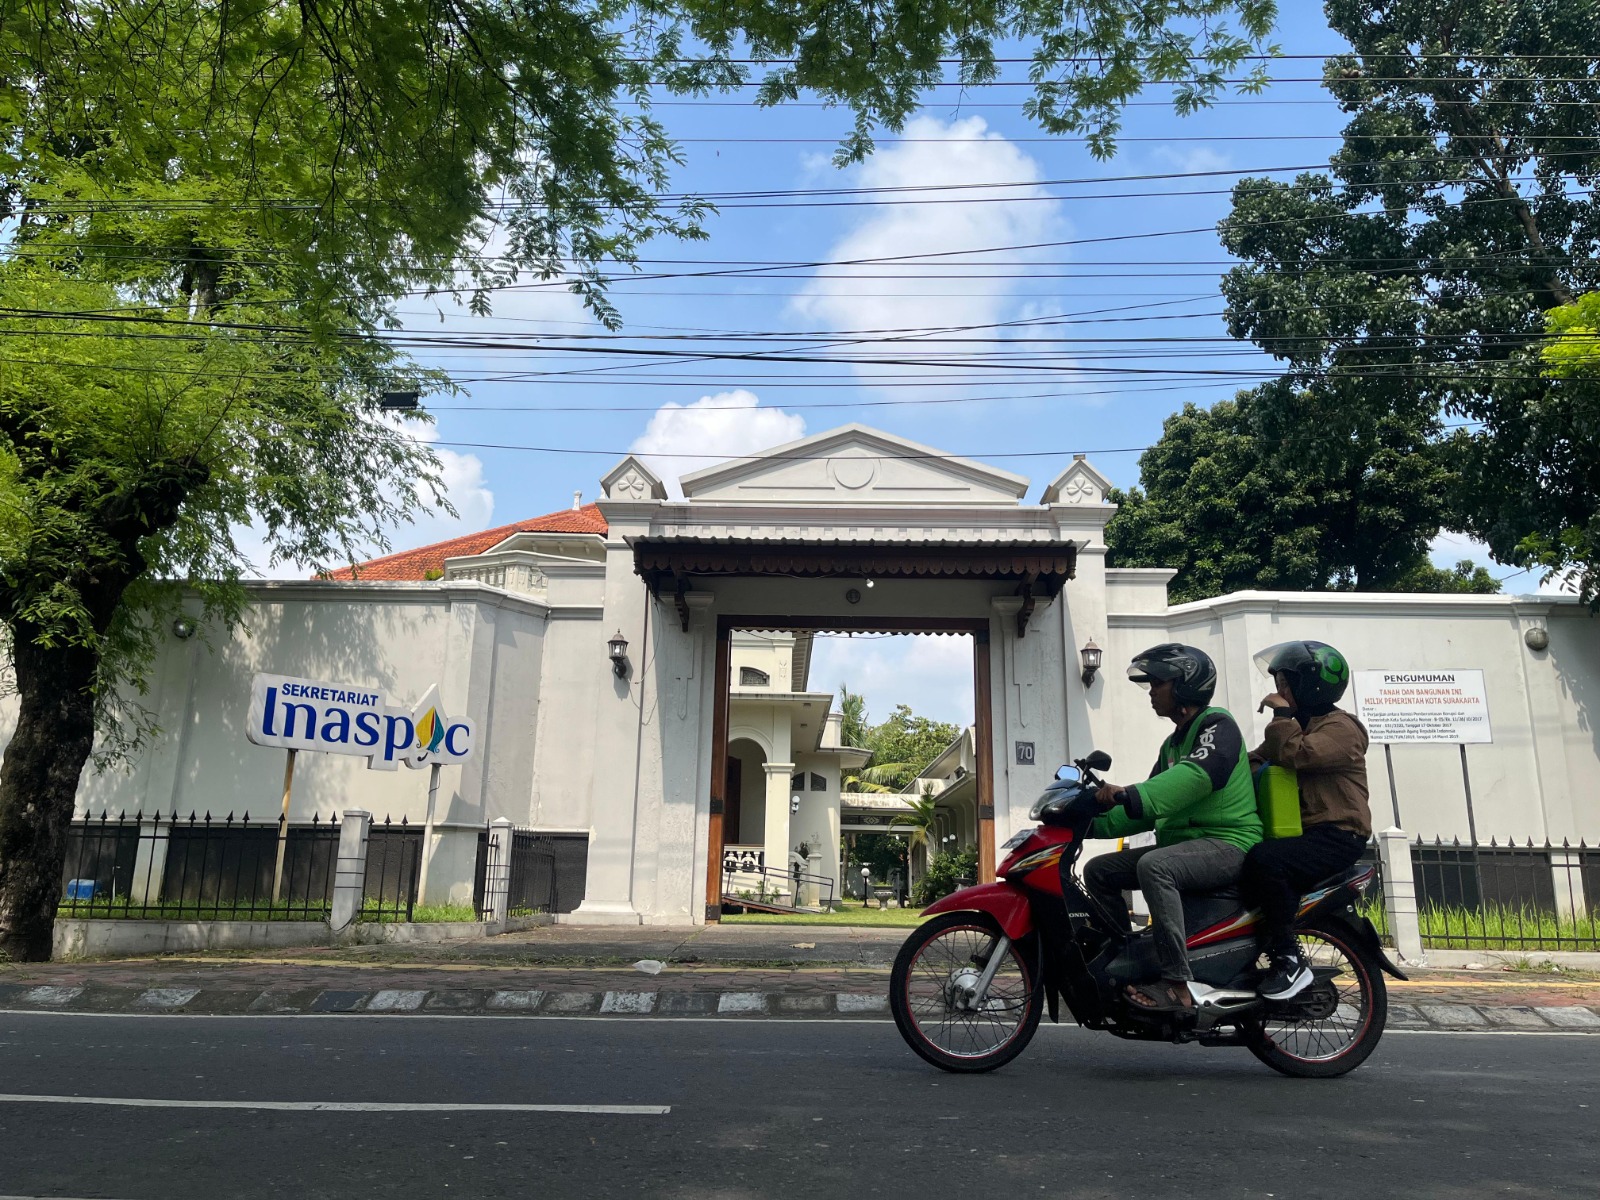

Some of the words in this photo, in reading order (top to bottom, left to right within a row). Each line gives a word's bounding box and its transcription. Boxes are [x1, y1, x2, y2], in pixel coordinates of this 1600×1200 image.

[1384, 674, 1455, 682] PENGUMUMAN
[282, 683, 378, 707] SEKRETARIAT
[1018, 745, 1033, 760] 70
